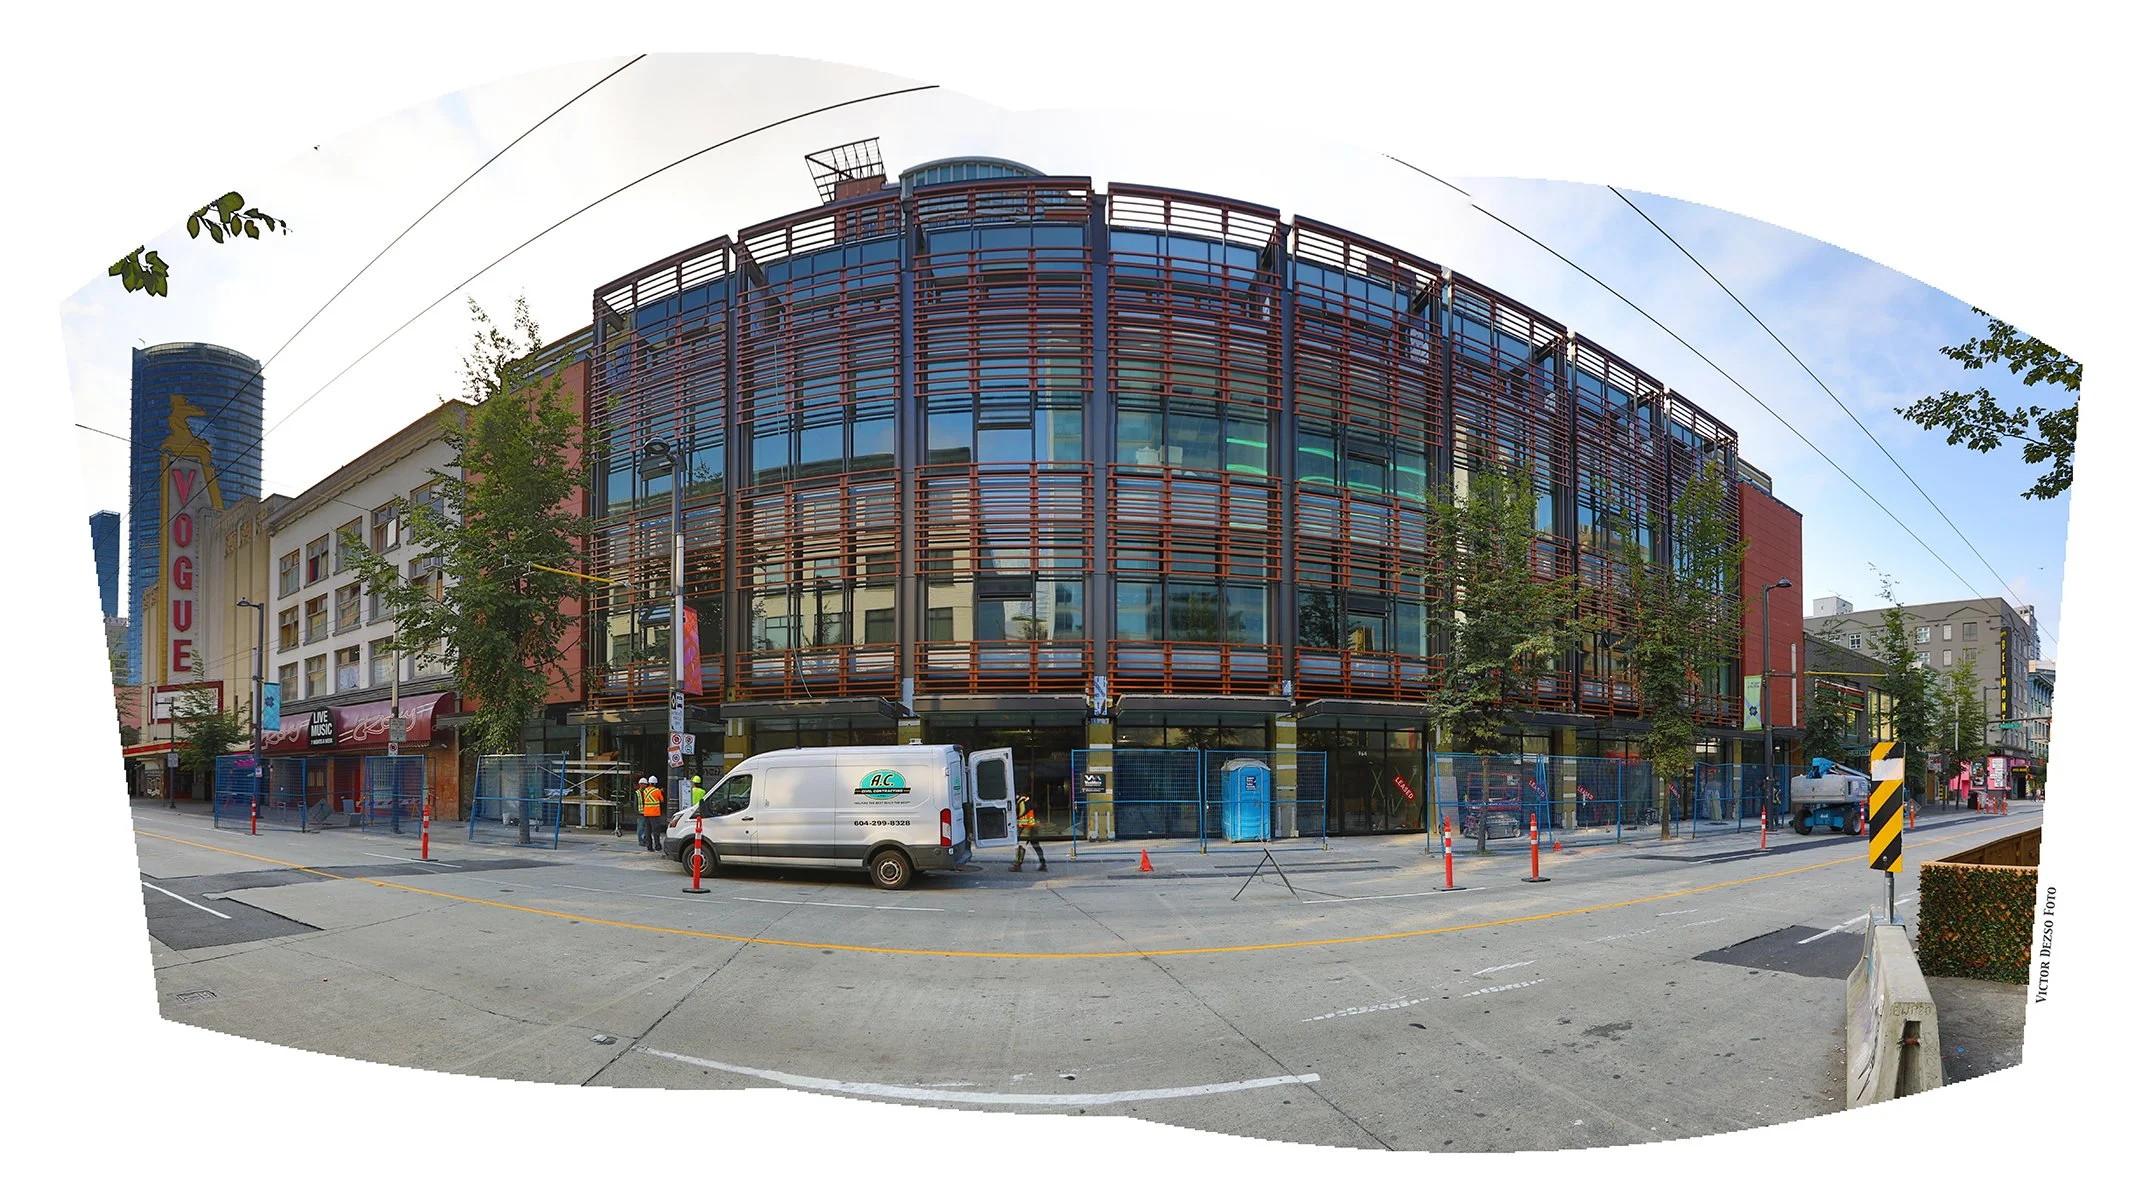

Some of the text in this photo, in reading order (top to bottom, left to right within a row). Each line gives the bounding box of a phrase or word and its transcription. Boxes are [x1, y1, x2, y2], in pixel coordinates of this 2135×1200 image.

[172, 469, 196, 672] VOGUE
[313, 710, 328, 724] LIVE
[310, 722, 333, 737] MUSIC
[871, 774, 894, 786] A.C.
[1394, 776, 1414, 800] LEASED
